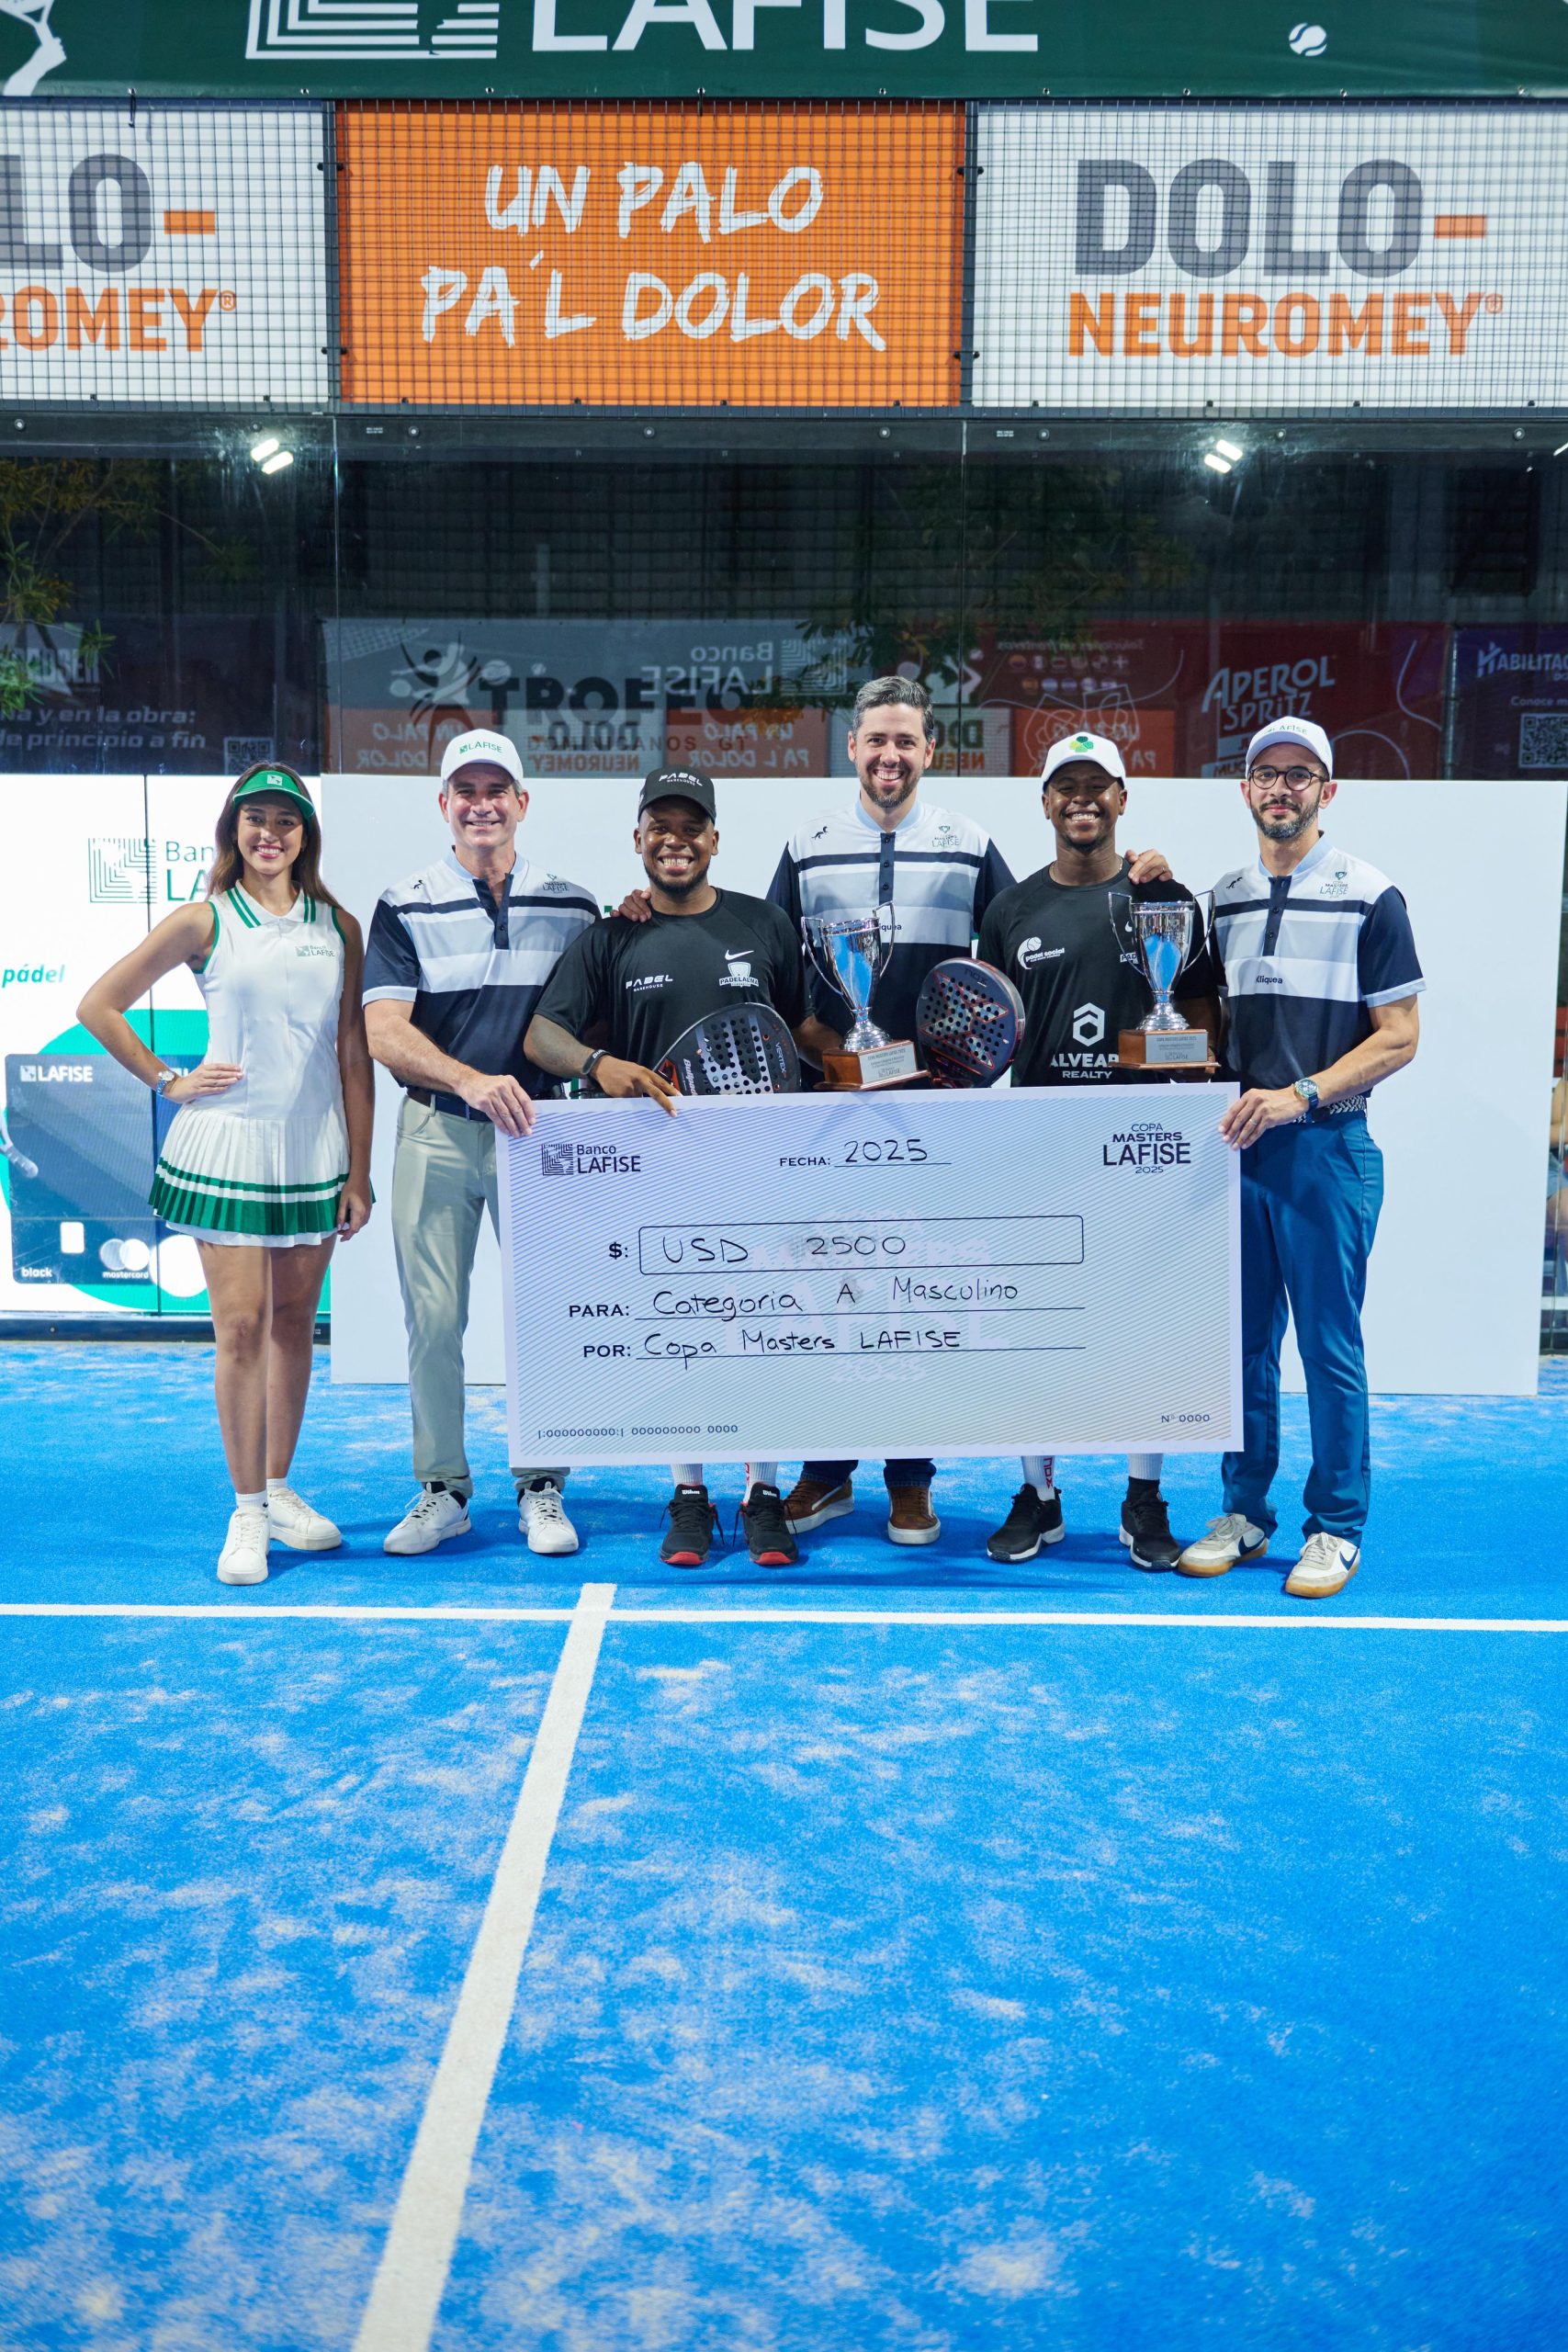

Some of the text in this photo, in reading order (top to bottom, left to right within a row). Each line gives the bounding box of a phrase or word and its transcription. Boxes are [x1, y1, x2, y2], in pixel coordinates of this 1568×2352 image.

[484, 162, 824, 243] UN PALO
[0, 286, 236, 353] OMEY®
[622, 271, 887, 351] DOLOR
[1201, 656, 1337, 714] APEROL
[35, 708, 54, 727] y
[59, 708, 91, 722] en
[97, 706, 121, 723] la
[127, 706, 197, 723] obra:
[27, 730, 144, 751] principio
[150, 735, 165, 749] a
[172, 730, 206, 749] fin
[468, 741, 502, 753] LAFISE
[659, 773, 703, 786] PADEL
[1043, 947, 1065, 956] social
[2, 964, 65, 989] pádel
[626, 975, 673, 989] PADEL
[776, 1042, 786, 1074] VERTEX
[38, 1066, 94, 1082] LAFISE
[1131, 1123, 1164, 1132] COPA
[1112, 1132, 1182, 1142] MASTERS
[577, 1144, 616, 1155] Banco
[779, 1139, 928, 1167] FECHA: 2025
[1103, 1143, 1191, 1166] LAFISE
[578, 1156, 641, 1174] LAFISE
[1135, 1166, 1164, 1174] 2025
[609, 1236, 906, 1263] $: USD 2500
[21, 1267, 52, 1278] black
[103, 1271, 150, 1280] mastercard
[569, 1275, 1018, 1321] PARA: Categoria A Masculino
[583, 1329, 961, 1370] POR: Copa Masters LAFISE
[1179, 1414, 1210, 1422] 0000
[707, 1424, 739, 1434] 0000
